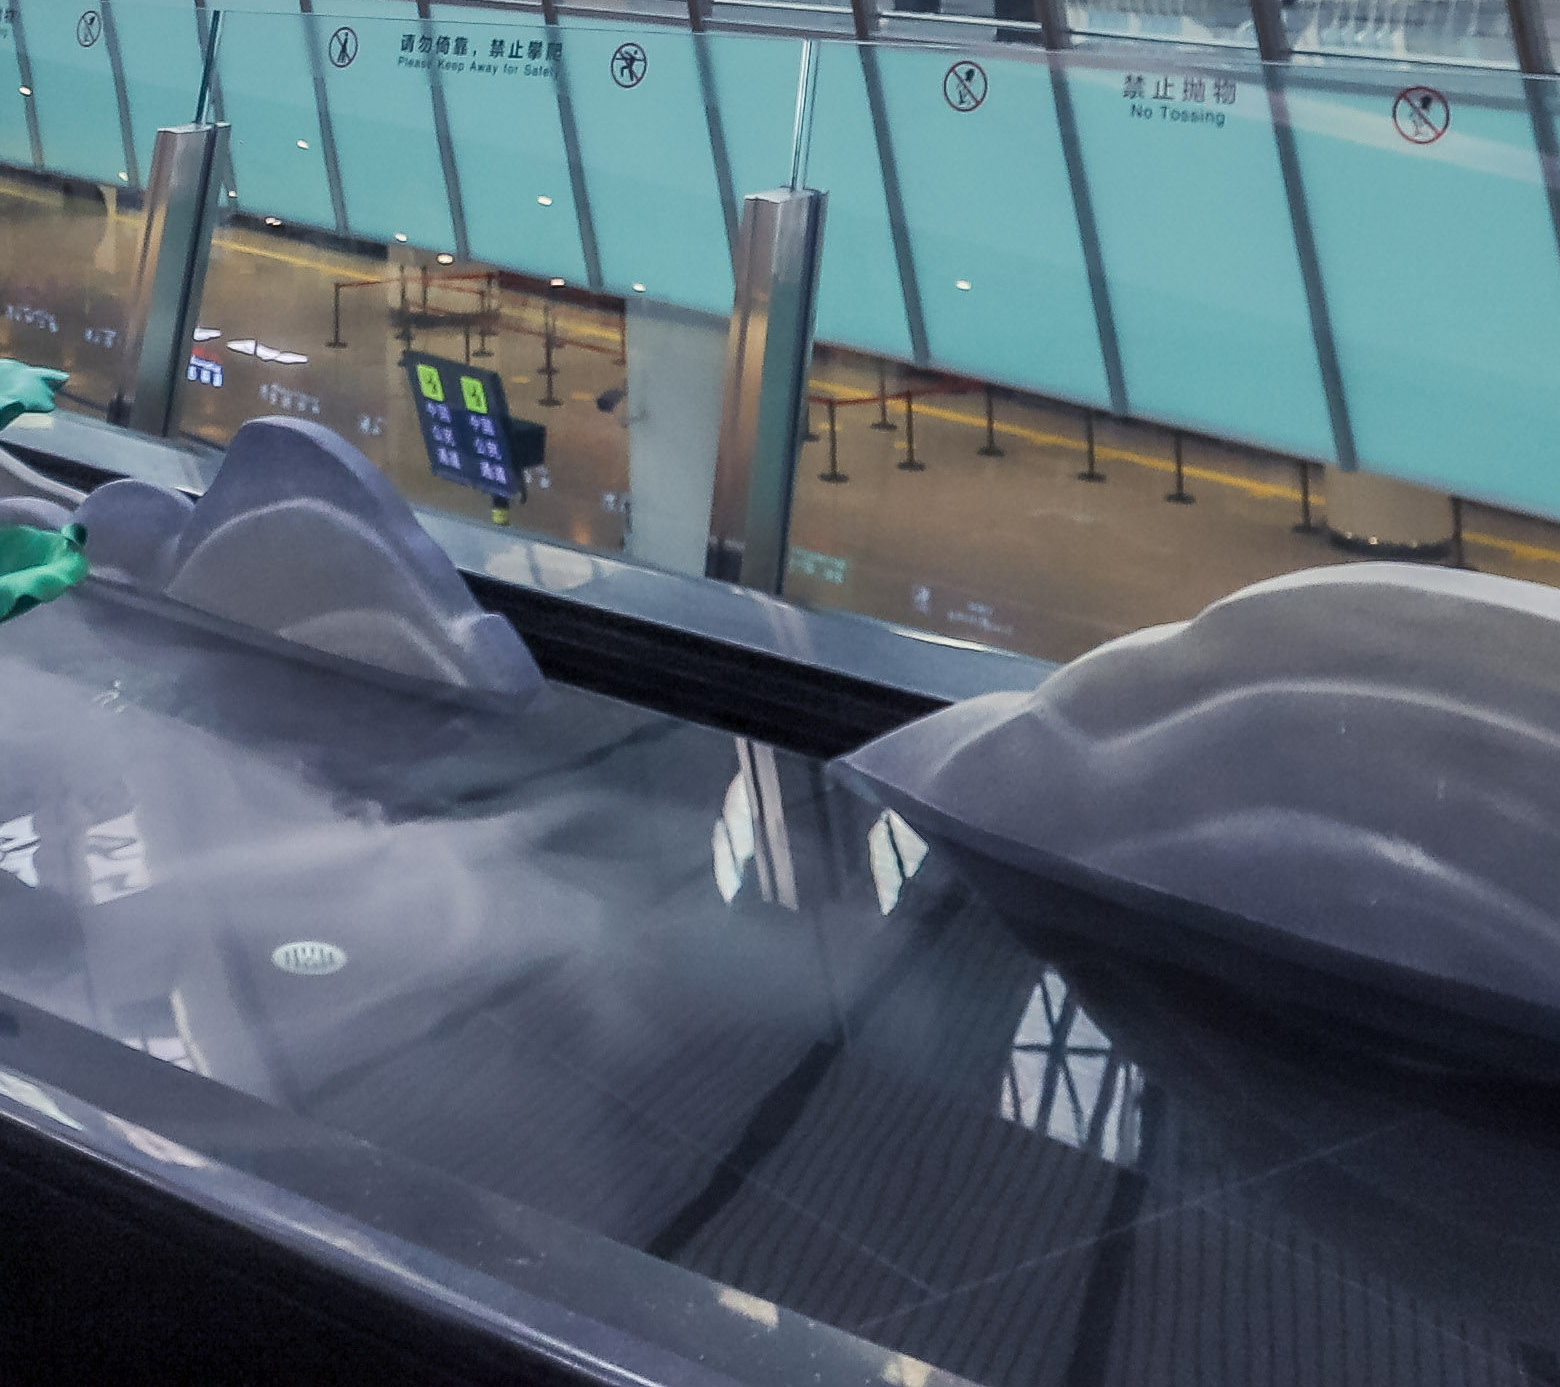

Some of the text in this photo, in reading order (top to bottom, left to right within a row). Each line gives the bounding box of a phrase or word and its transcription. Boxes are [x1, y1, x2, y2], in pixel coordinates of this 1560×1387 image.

[438, 59, 464, 73] Keep
[470, 61, 498, 76] Away
[504, 63, 518, 74] for
[1130, 104, 1226, 128] No Tossing
